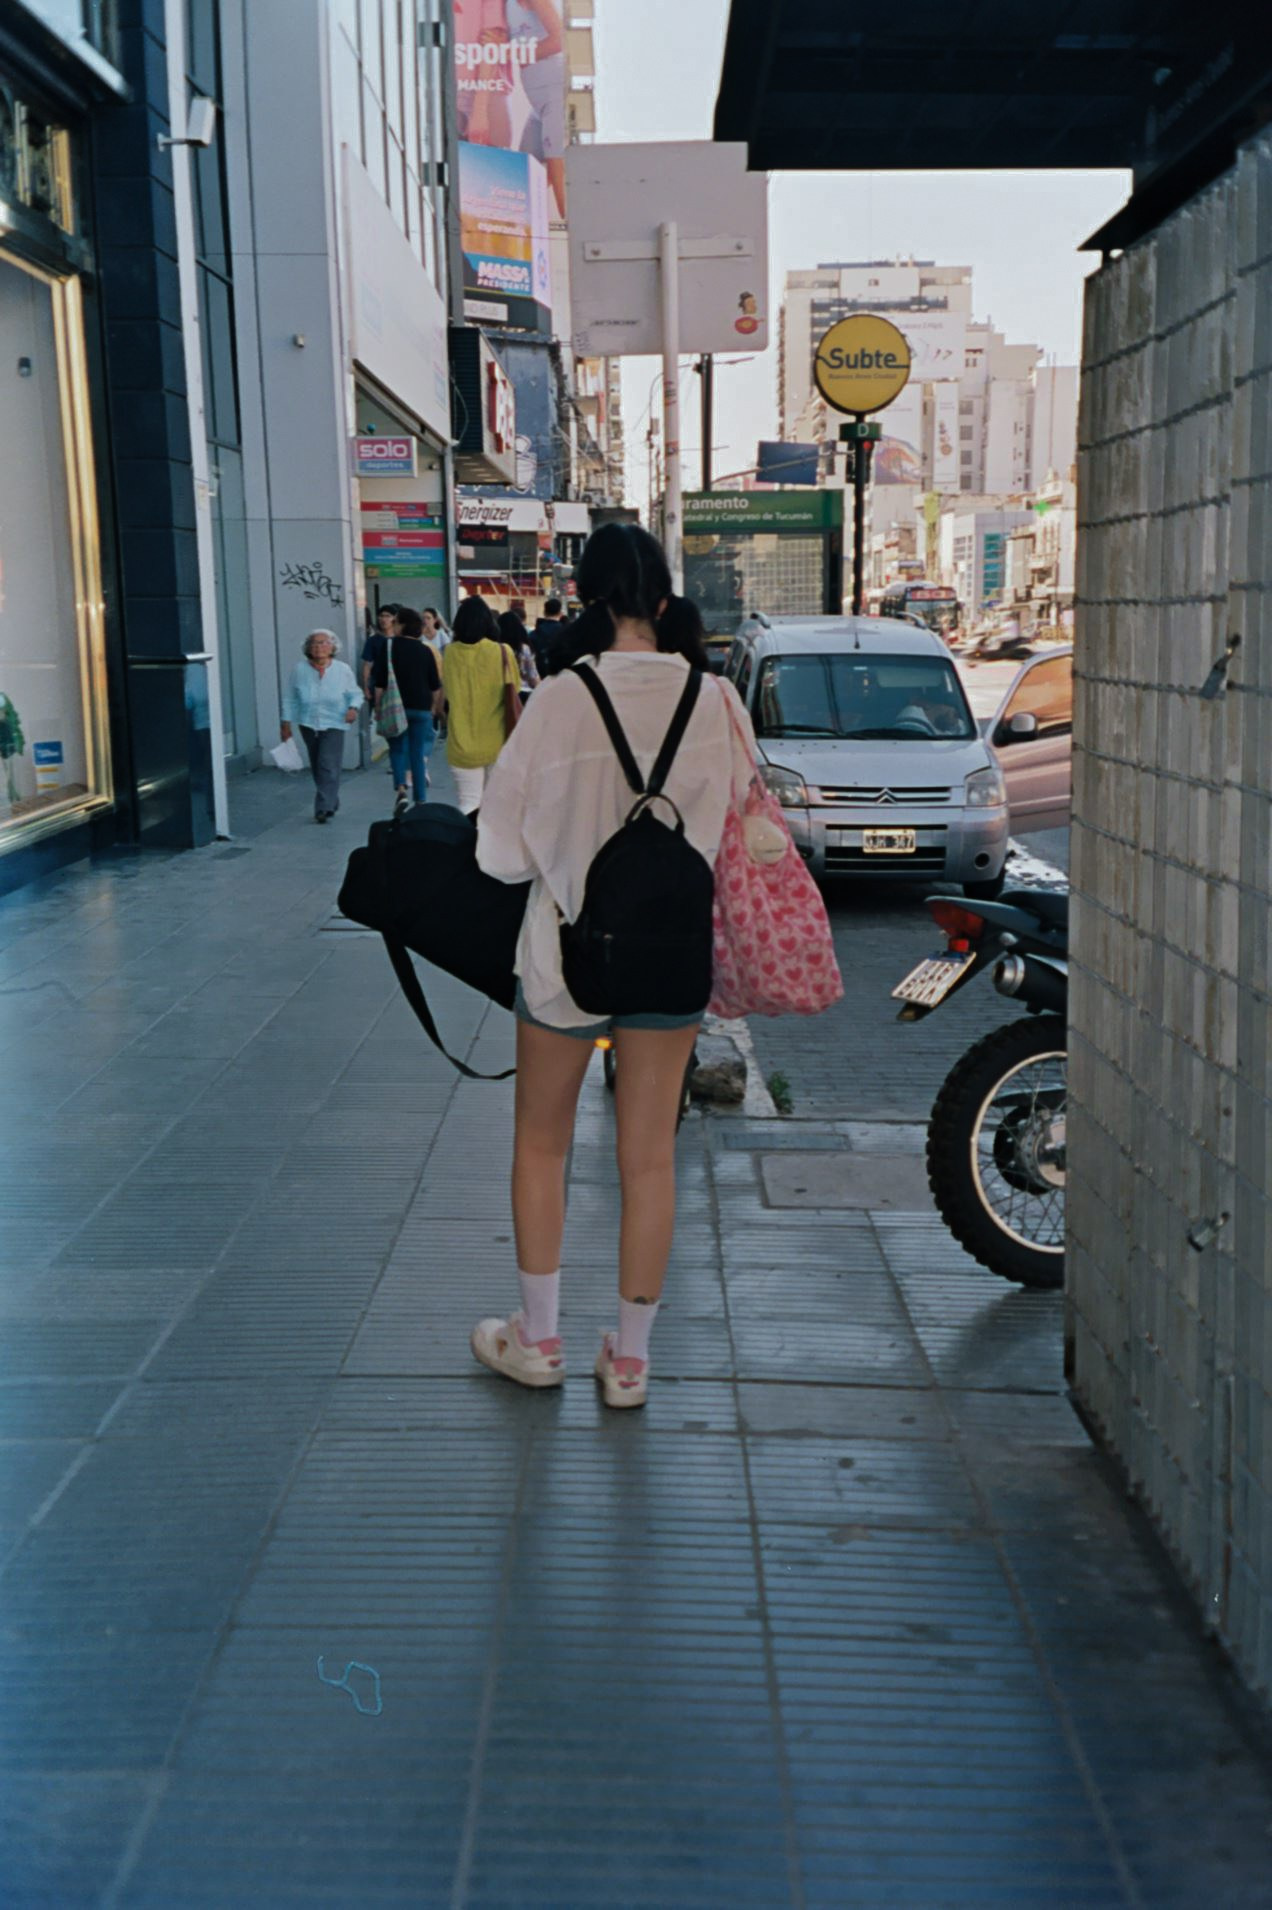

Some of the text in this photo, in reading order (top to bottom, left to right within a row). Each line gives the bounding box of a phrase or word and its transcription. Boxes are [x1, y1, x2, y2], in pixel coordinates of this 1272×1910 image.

[454, 36, 538, 70] sportif
[477, 261, 529, 282] MASSA
[477, 277, 530, 291] PRESIDENTE
[827, 347, 898, 368] Subte
[857, 423, 869, 437] D
[359, 440, 408, 458] solo
[683, 497, 749, 509] ramento
[714, 514, 719, 523] y
[721, 512, 760, 523] Congreso
[762, 512, 773, 520] de
